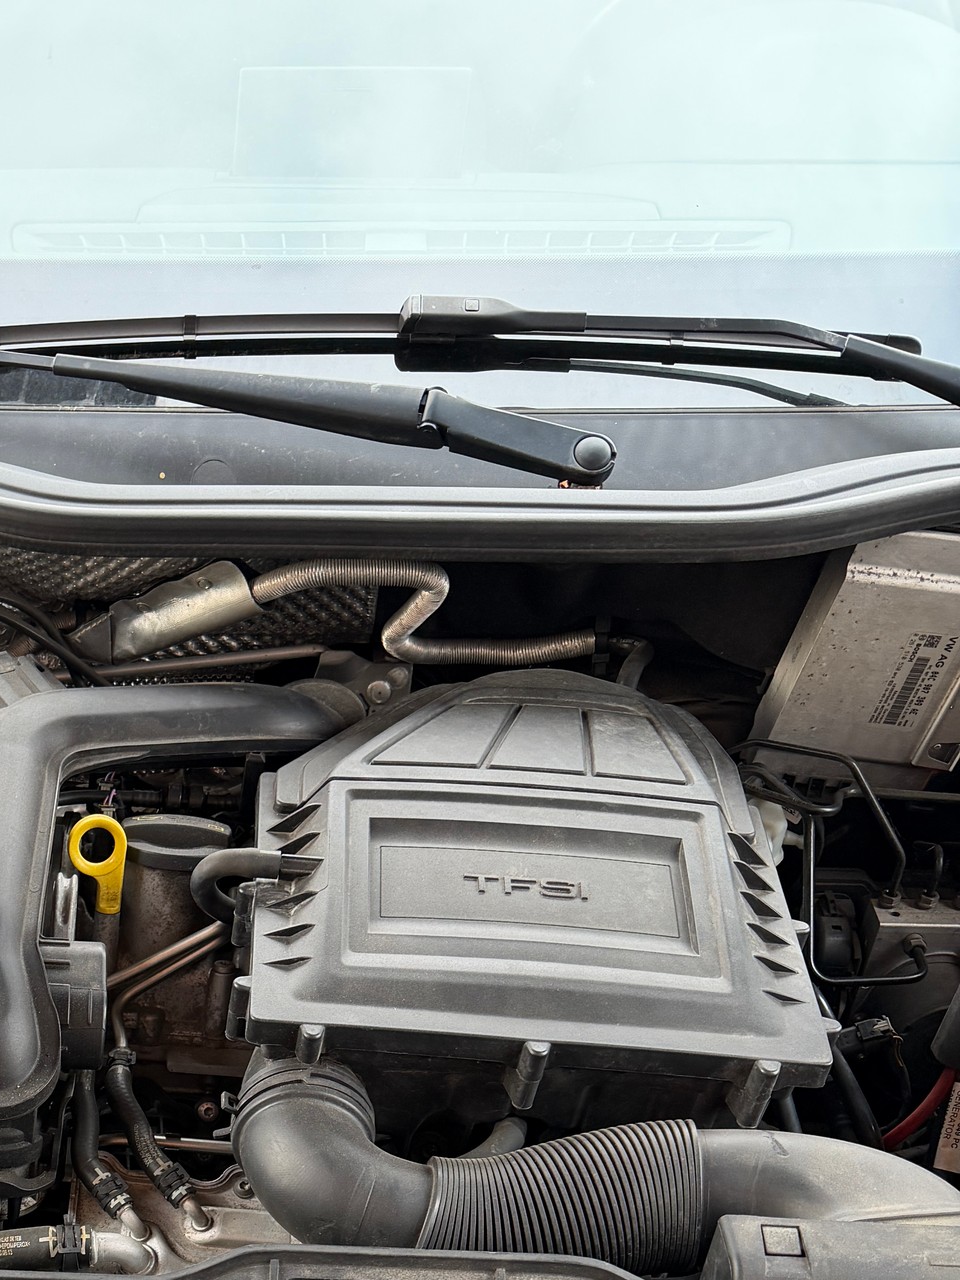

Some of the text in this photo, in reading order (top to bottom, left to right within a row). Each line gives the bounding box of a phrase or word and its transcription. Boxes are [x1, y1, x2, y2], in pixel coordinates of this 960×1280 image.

[907, 643, 922, 663] BOSCH
[944, 636, 959, 653] VW
[935, 653, 948, 668] AG
[463, 873, 590, 901] TFSI
